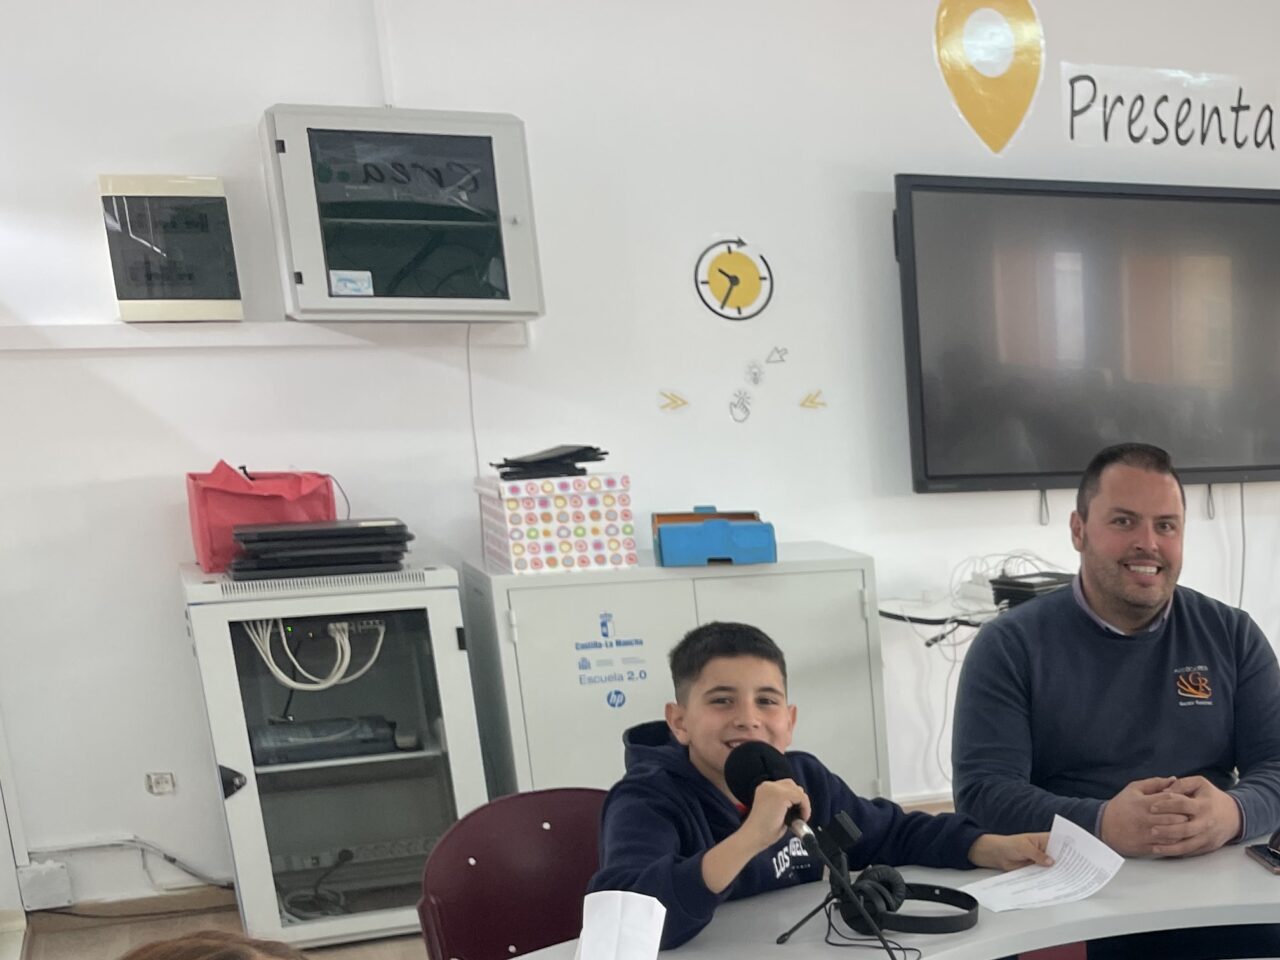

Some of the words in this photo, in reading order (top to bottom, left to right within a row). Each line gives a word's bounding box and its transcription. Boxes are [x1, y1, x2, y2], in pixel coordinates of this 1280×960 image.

[1069, 74, 1275, 151] Presenta
[579, 671, 625, 685] Escuela
[626, 669, 647, 681] 2.0
[772, 846, 790, 879] LOS
